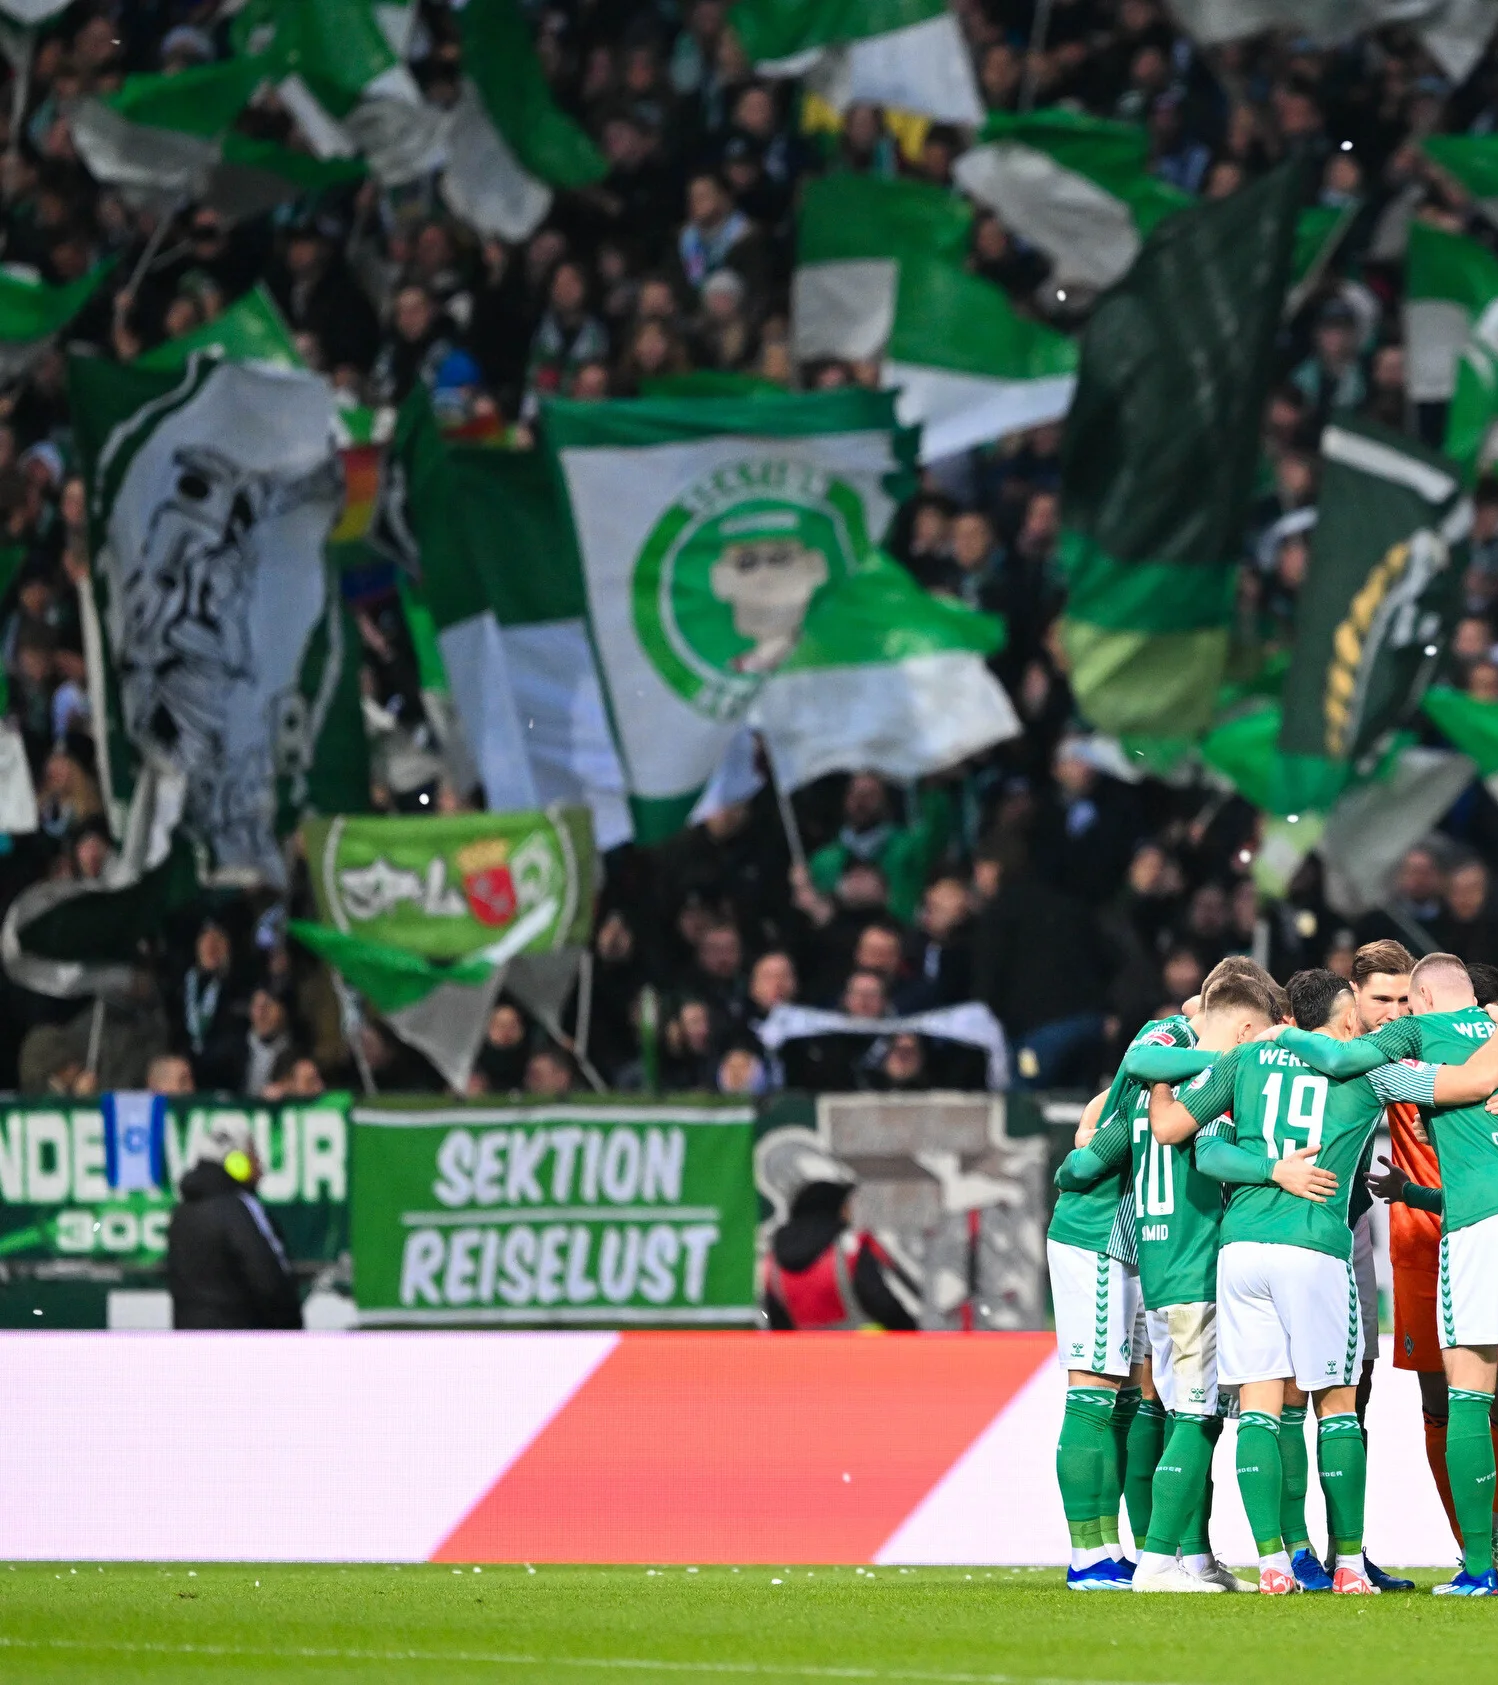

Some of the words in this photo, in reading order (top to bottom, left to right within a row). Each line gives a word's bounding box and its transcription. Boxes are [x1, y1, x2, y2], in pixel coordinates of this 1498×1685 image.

[1259, 1049, 1310, 1067] WER
[1262, 1073, 1328, 1166] 19
[432, 1126, 687, 1206] SEKTION
[401, 1224, 720, 1306] REISELUST
